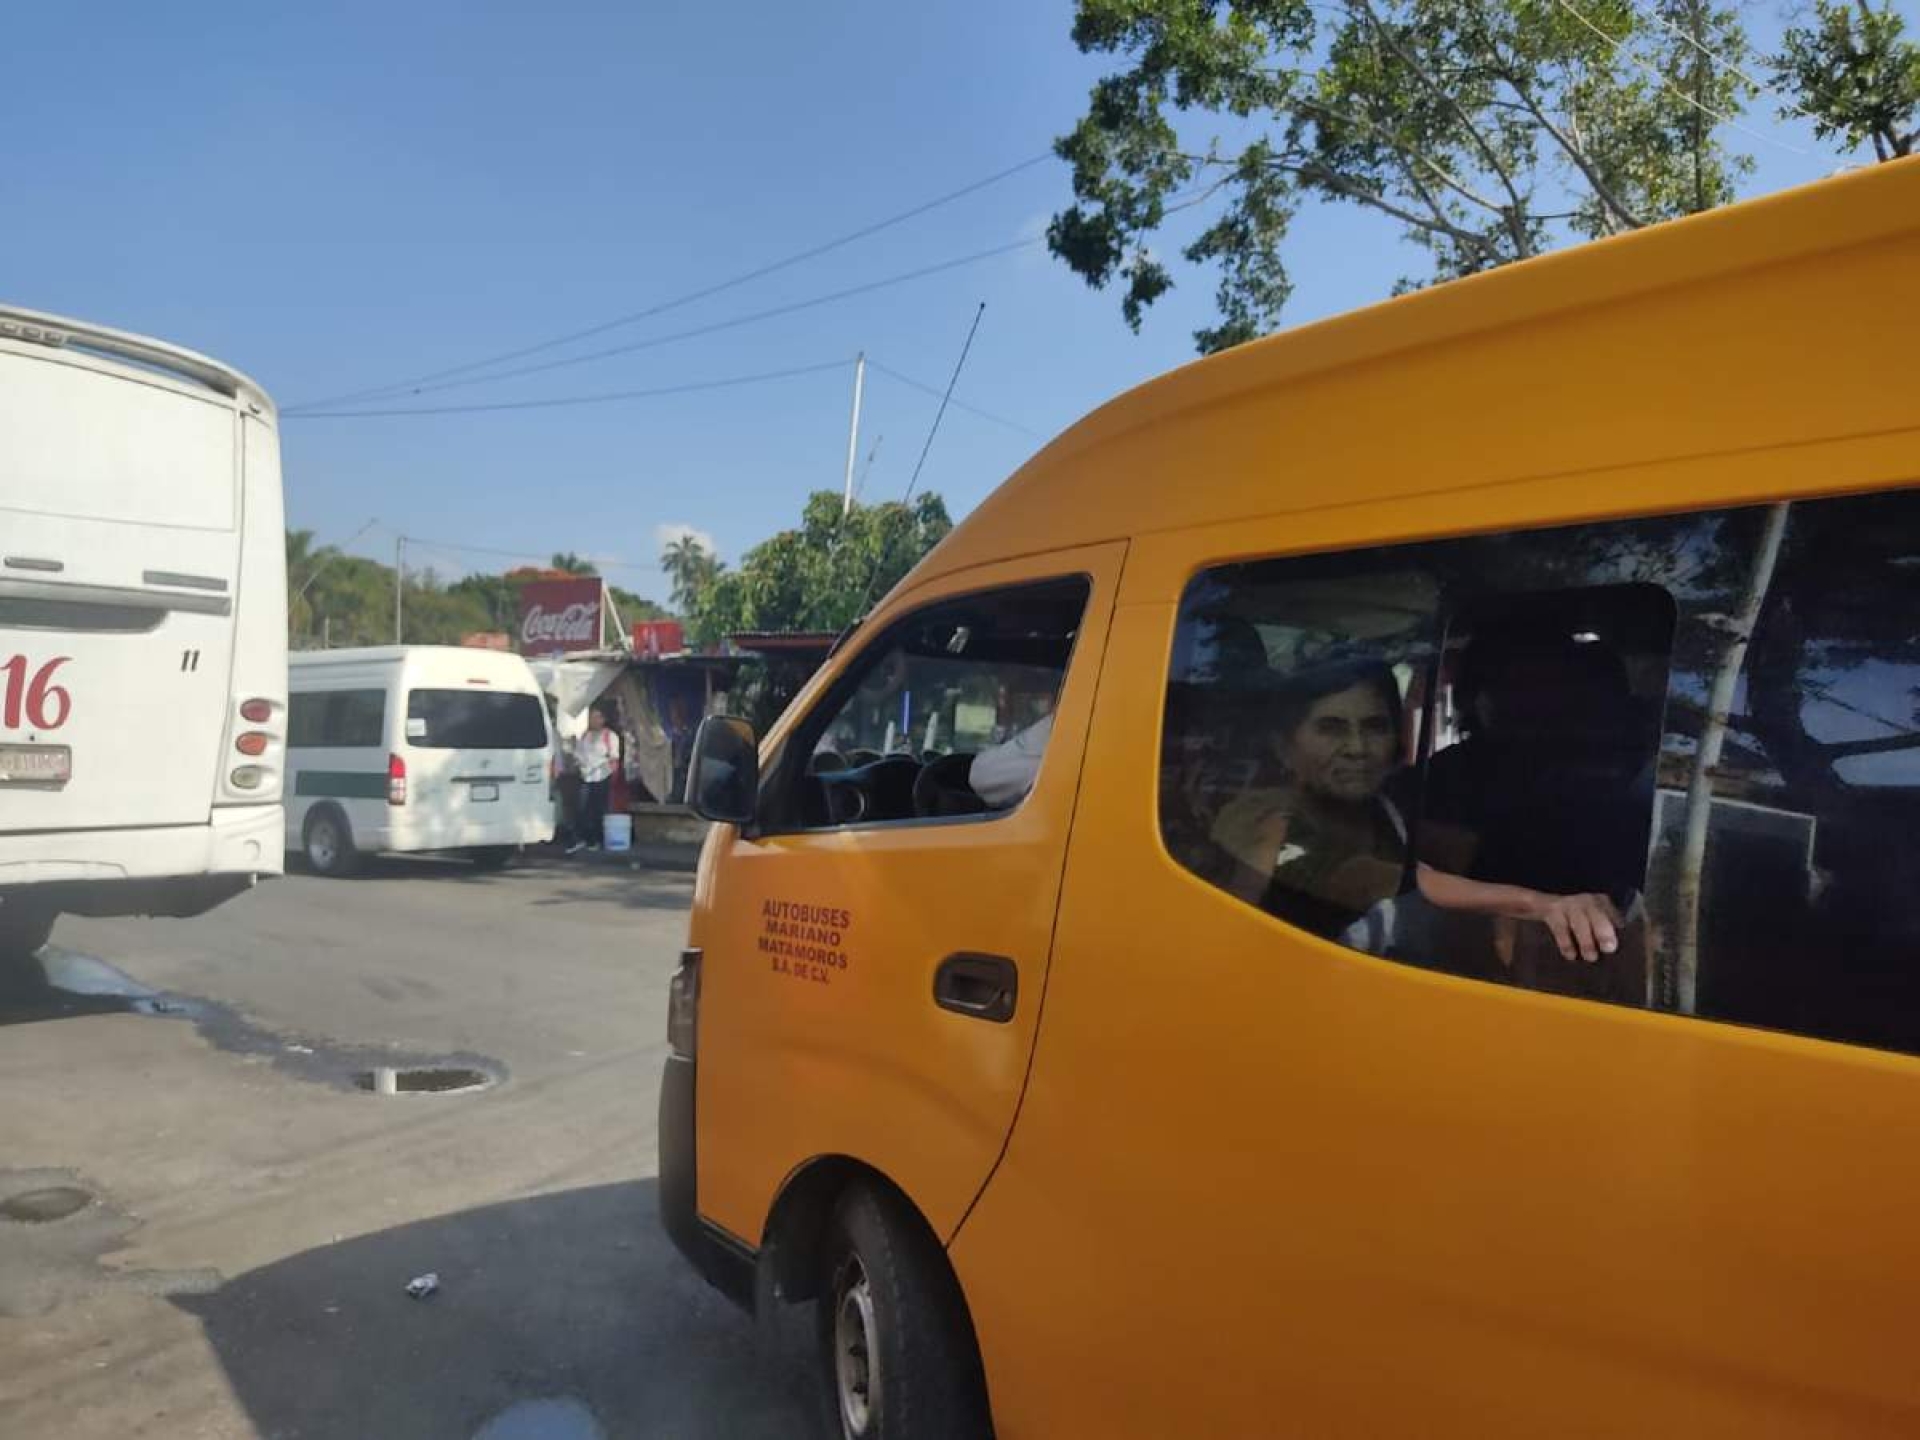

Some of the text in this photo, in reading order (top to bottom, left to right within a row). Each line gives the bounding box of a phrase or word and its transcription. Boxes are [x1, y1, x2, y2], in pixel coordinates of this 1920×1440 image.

[0, 654, 73, 730] 16
[762, 899, 850, 928] AUTOBUSES
[766, 920, 840, 947] MARIANO
[758, 936, 848, 969] MATAMOROS
[794, 962, 808, 979] DE
